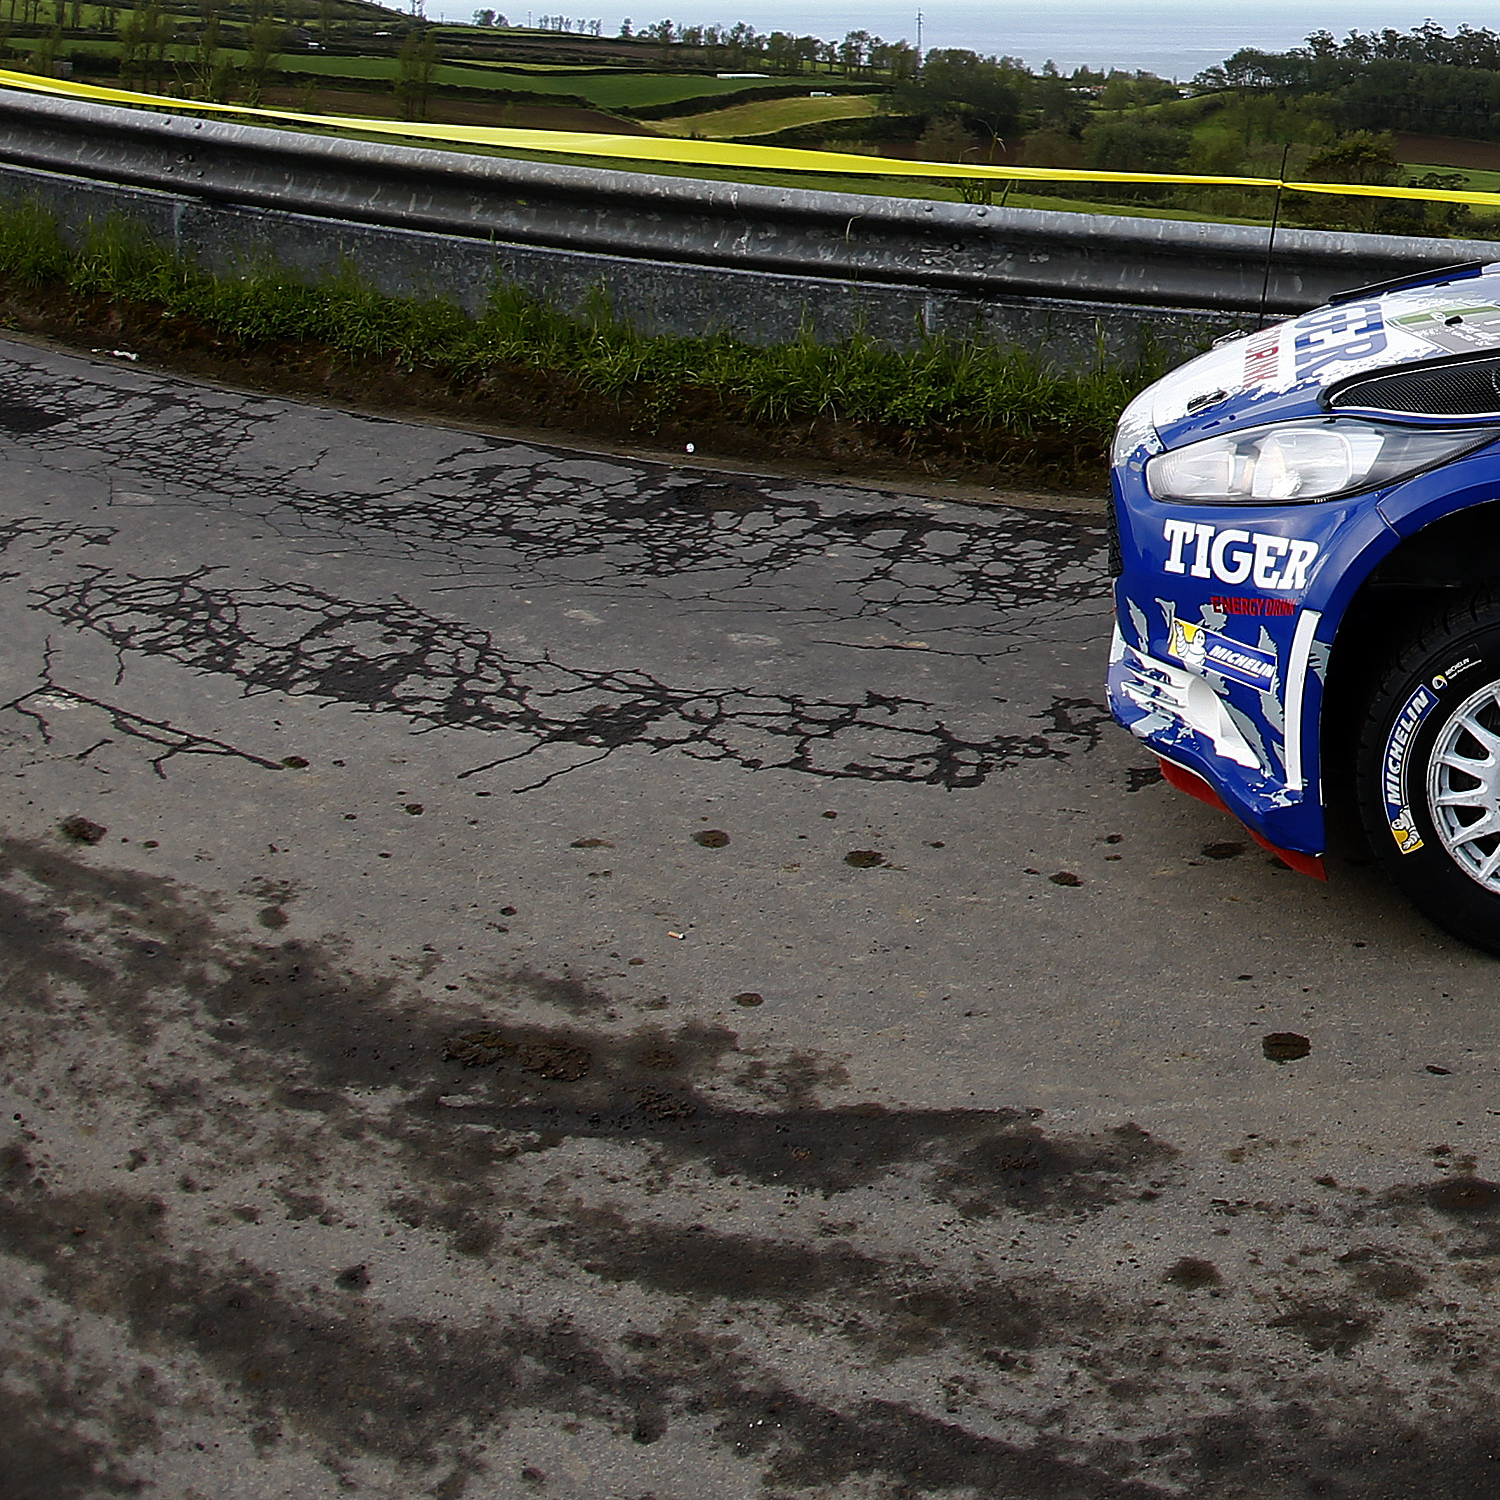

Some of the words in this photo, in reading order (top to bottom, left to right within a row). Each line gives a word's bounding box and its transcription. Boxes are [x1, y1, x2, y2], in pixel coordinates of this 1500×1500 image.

[1163, 518, 1319, 590] TIGER
[1210, 596, 1265, 617] ENERGY
[1265, 598, 1297, 617] DRINK
[1208, 644, 1277, 678] MICHELIN
[1386, 691, 1430, 807] MICHELIN
